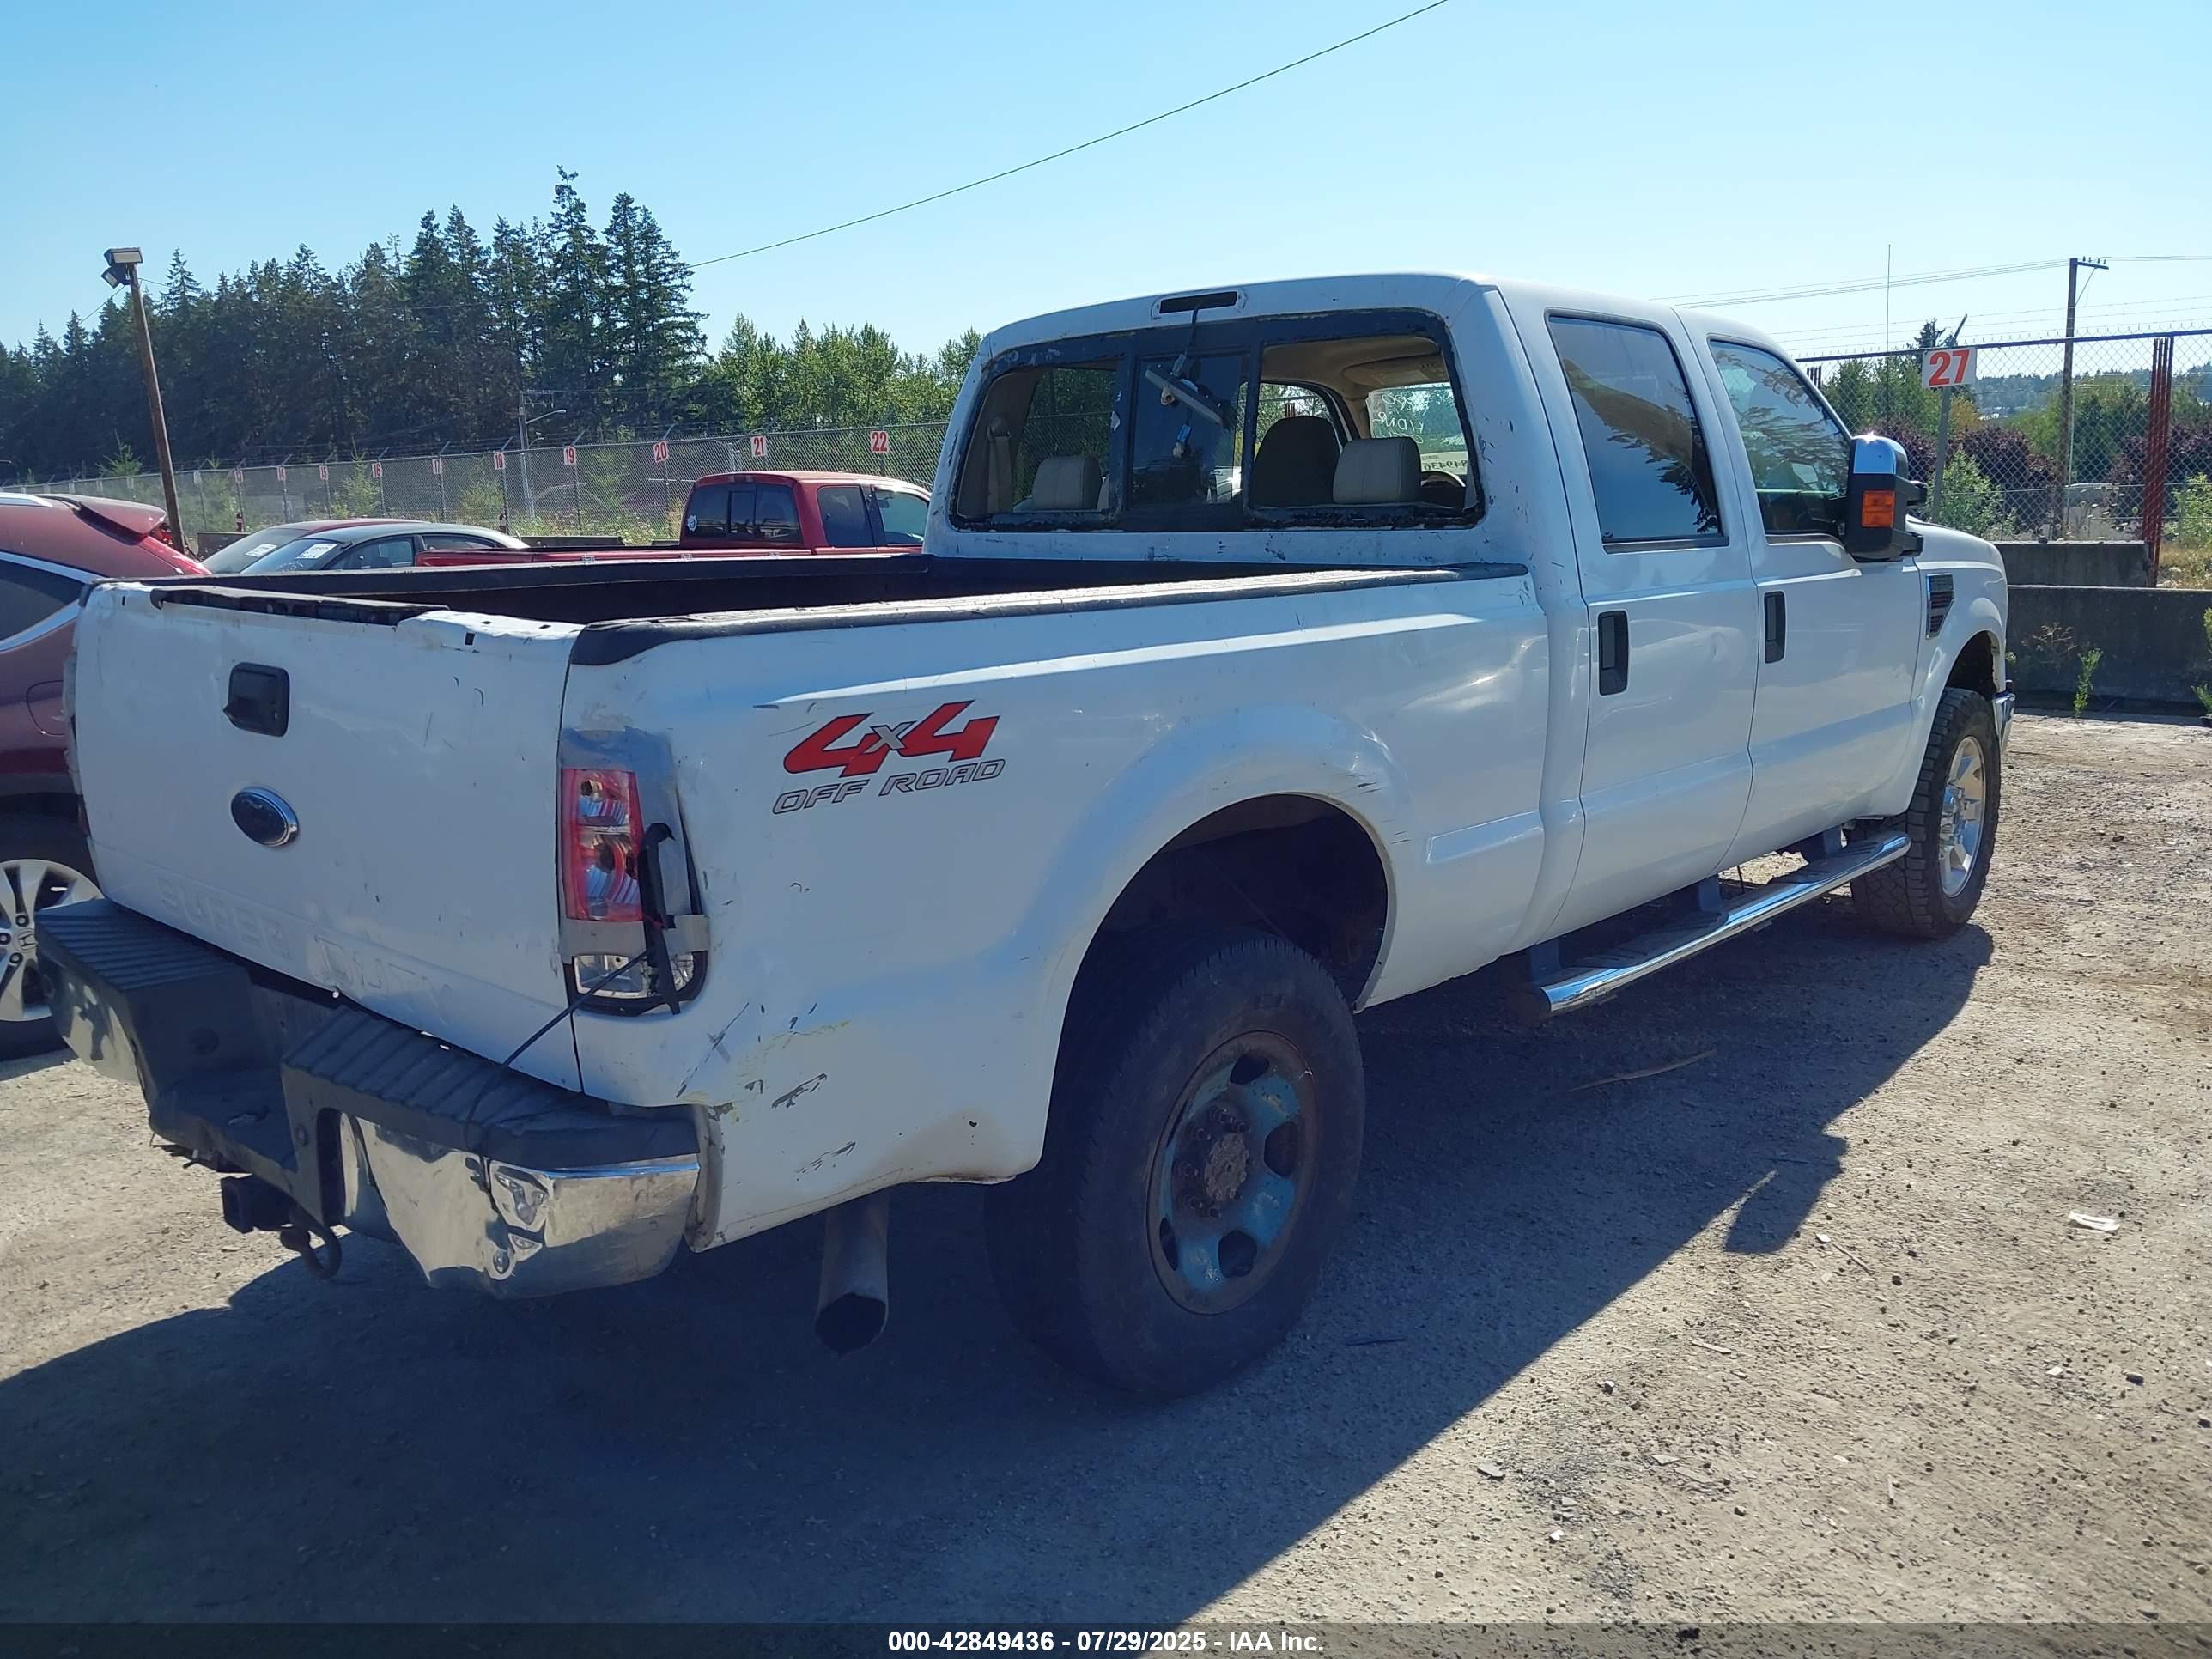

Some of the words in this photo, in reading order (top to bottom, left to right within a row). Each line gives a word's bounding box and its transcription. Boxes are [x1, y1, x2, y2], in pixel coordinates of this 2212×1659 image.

[1929, 349, 1970, 386] 27
[753, 437, 764, 456] 21
[872, 431, 887, 452] 22
[495, 453, 503, 468] 18
[565, 447, 574, 464] 19
[655, 443, 667, 461] 20
[320, 466, 327, 480] 15
[374, 464, 380, 477] 16
[772, 779, 871, 815] OFF
[878, 759, 1006, 797] ROAD
[156, 878, 295, 962] SUPER
